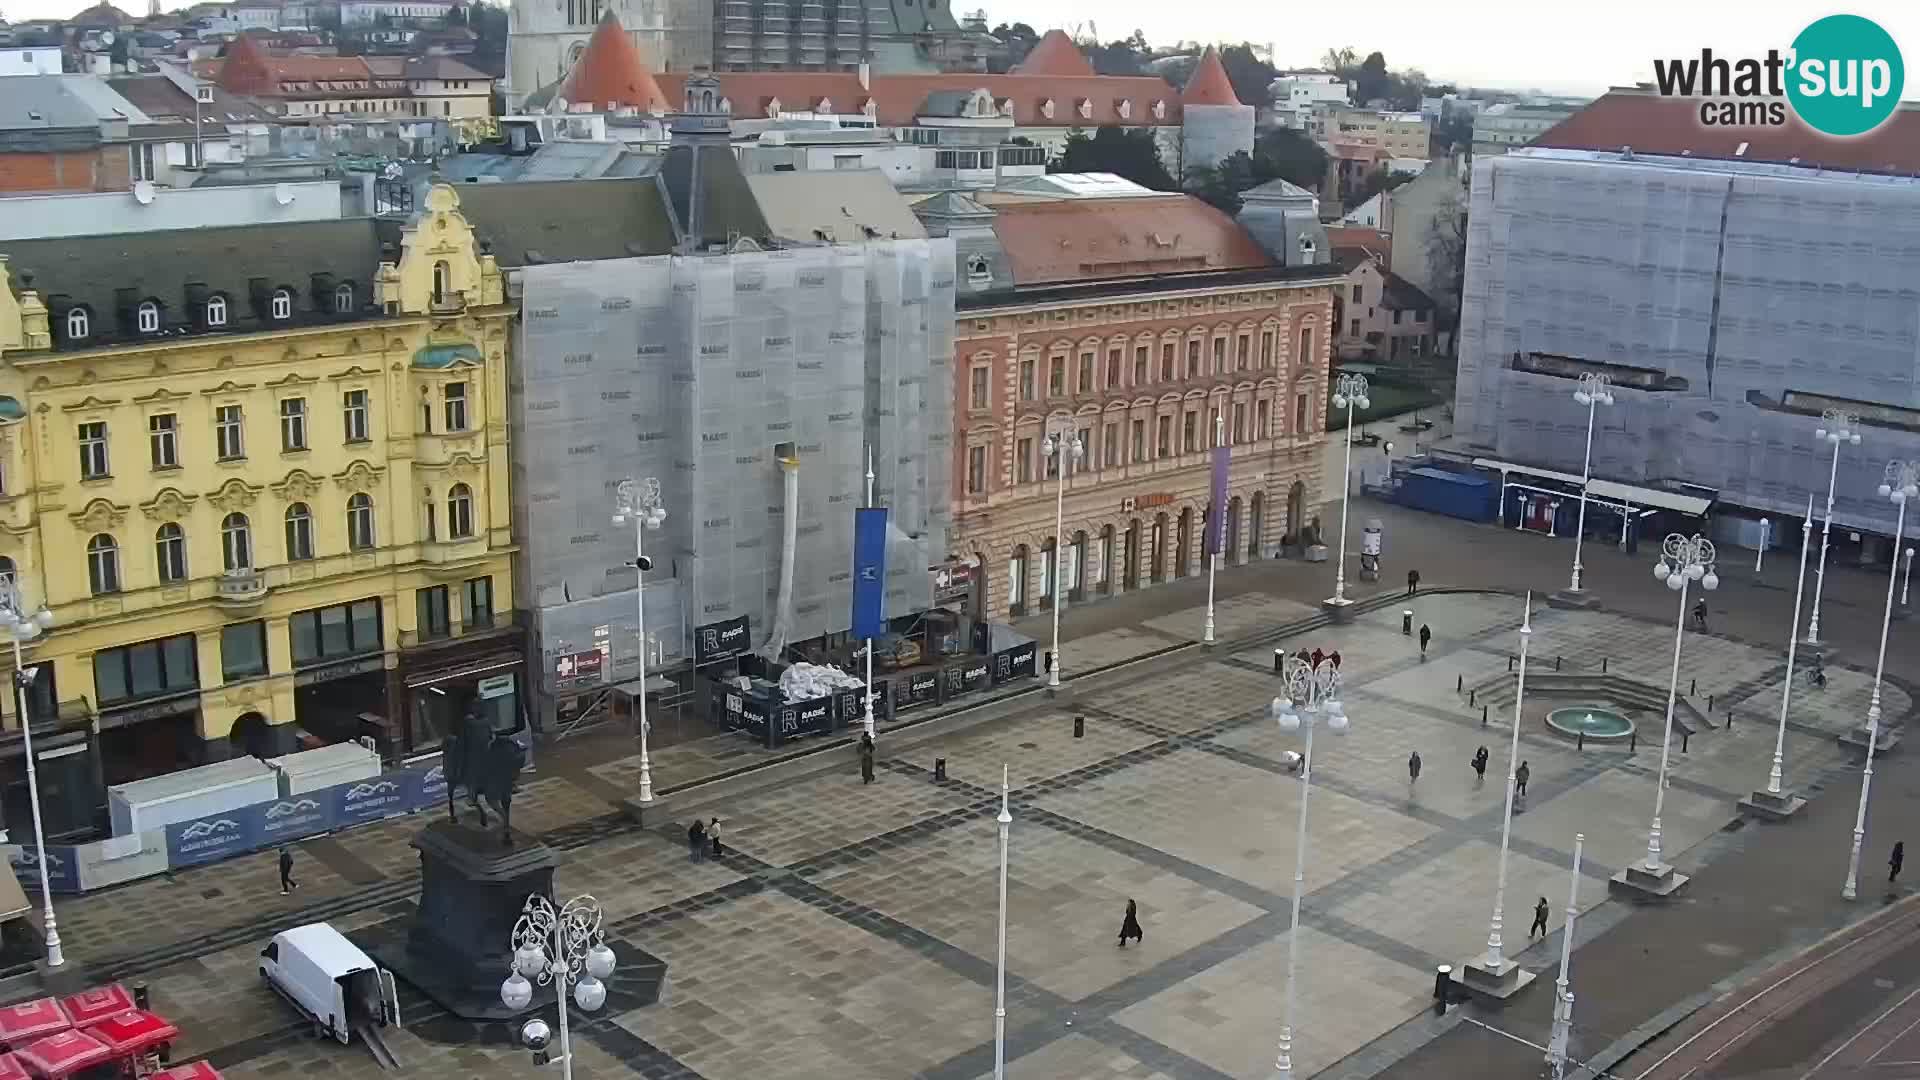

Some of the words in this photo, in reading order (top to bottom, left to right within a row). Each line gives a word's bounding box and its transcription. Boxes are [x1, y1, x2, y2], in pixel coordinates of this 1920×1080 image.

[703, 629, 719, 651] R
[998, 655, 1011, 677] R
[783, 710, 798, 732] R
